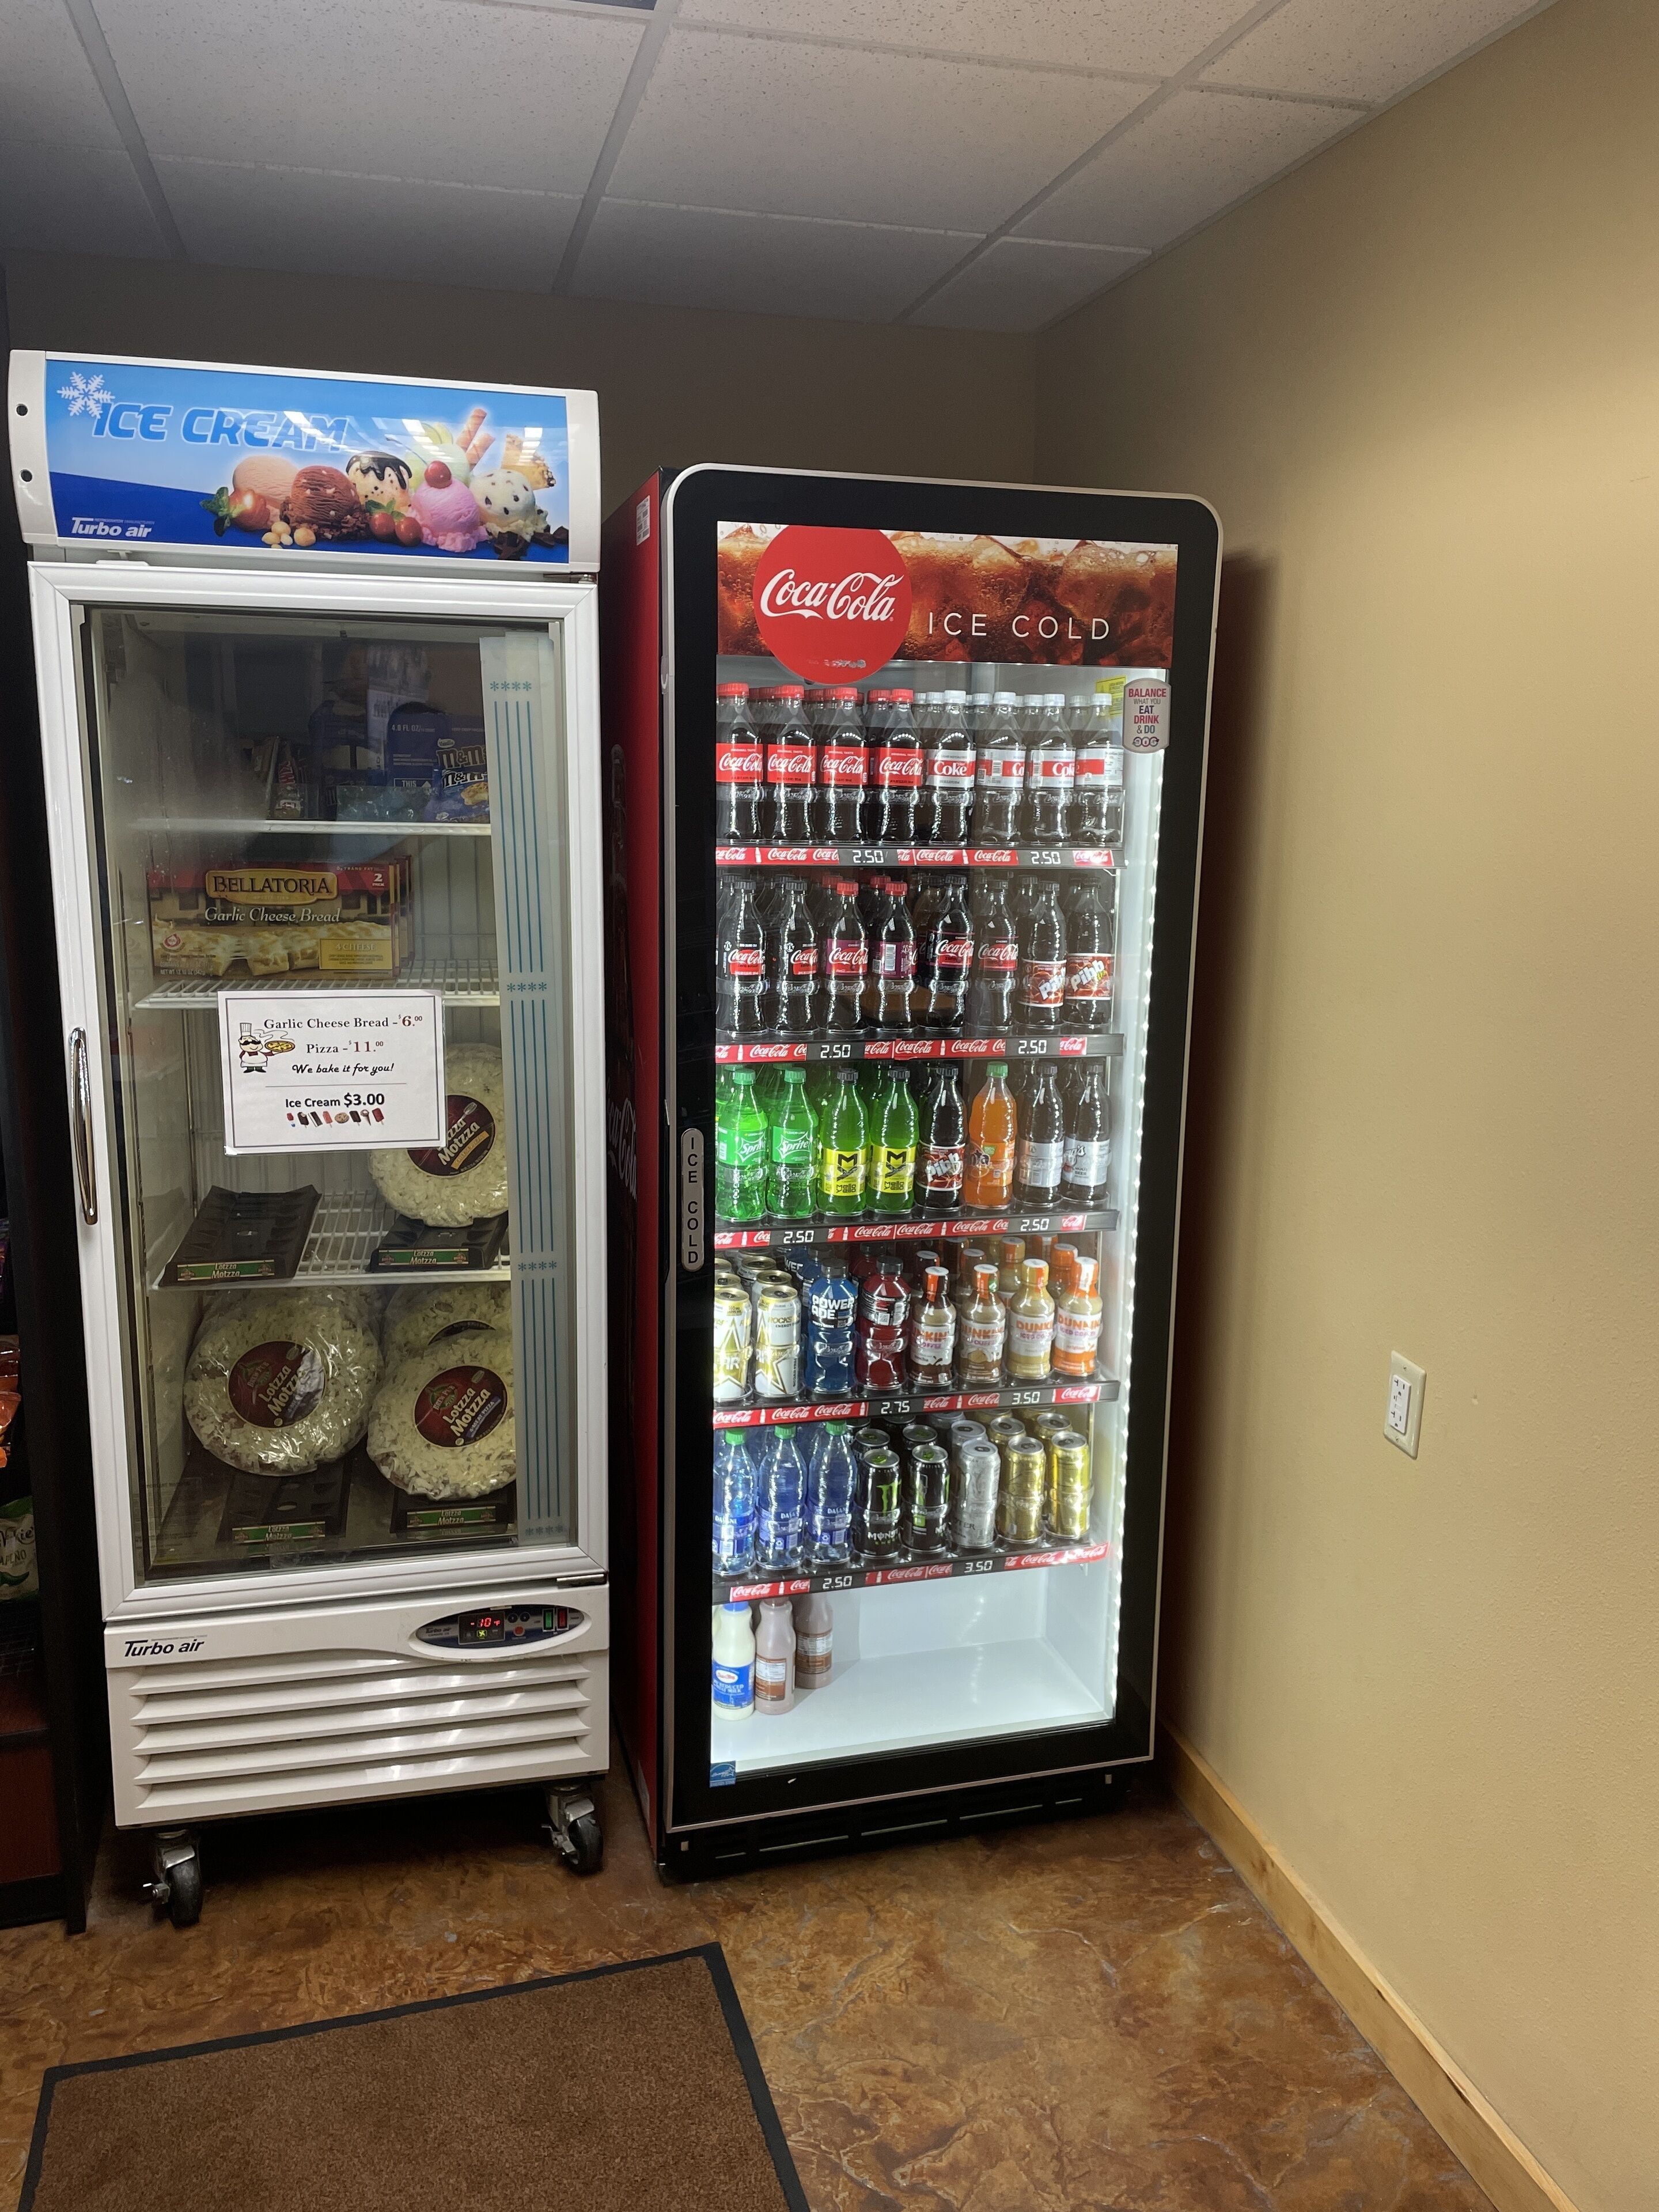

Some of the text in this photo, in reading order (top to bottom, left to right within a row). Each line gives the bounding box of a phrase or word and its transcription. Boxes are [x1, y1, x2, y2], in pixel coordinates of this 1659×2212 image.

[92, 403, 347, 452] ICE CREAM
[72, 517, 151, 537] Turbo air
[760, 568, 904, 622] Coca-Cola
[928, 612, 1110, 640] ICE COLD
[1129, 688, 1166, 698] BALANCE
[1139, 706, 1154, 714] EAT
[1134, 715, 1159, 724] DRINK
[1137, 725, 1155, 734] & DO
[768, 754, 813, 772] Coca-Cola
[820, 755, 865, 774] Coca-Cola
[934, 761, 968, 776] Coke
[767, 847, 808, 861] Coca-Cola
[853, 850, 884, 863] 2.50
[916, 849, 955, 862] Coca-Cola
[974, 849, 1012, 862] Coca-Cola
[1030, 851, 1061, 865] 2.50
[374, 873, 382, 882] 2
[213, 876, 332, 895] BELLATORIA
[205, 907, 340, 922] Garlic Cheese Bread
[264, 1018, 303, 1029] Garlic
[307, 1017, 350, 1028] Cheese
[353, 1017, 389, 1027] Bread
[306, 1043, 339, 1054] Pizza
[749, 1044, 789, 1058] Coca-Cola
[820, 1044, 851, 1058] 2.50
[895, 1040, 934, 1054] Coca-Cola
[951, 1039, 990, 1052] Coca-Cola
[1018, 1040, 1047, 1054] 2.50
[292, 1063, 395, 1076] We bake it for you!
[286, 1092, 384, 1108] Ice Cream $3.00
[438, 1122, 480, 1165] Motzza
[781, 1140, 810, 1152] Sprite
[687, 1137, 699, 1264] ICE COLD
[854, 1225, 893, 1238] Coca-Cola
[896, 1222, 935, 1237] Coca-Cola
[952, 1219, 989, 1233] Coca-Cola
[1020, 1218, 1050, 1232] 2.50
[783, 1230, 814, 1244] 2.50
[410, 1257, 437, 1265] Motzza
[211, 1270, 240, 1279] Motzza
[812, 1294, 854, 1310] POWER
[812, 1305, 836, 1319] ADE
[258, 1365, 291, 1402] Lotzza
[1012, 1391, 1040, 1405] 3.50
[442, 1388, 476, 1423] Lotzza
[814, 1403, 854, 1416] Coca-Cola
[881, 1400, 910, 1414] 2.75
[450, 1389, 491, 1437] Motzza
[714, 1410, 752, 1424] Coca-Cola
[771, 1407, 810, 1420] Coca-Cola
[1021, 1552, 1058, 1565] Coca-Cola
[888, 1566, 923, 1580] Coca-Cola
[964, 1560, 993, 1573] 3.50
[823, 1575, 853, 1589] 2.50
[733, 1583, 772, 1597] Coca-Cola
[124, 1639, 204, 1657] Turbo air
